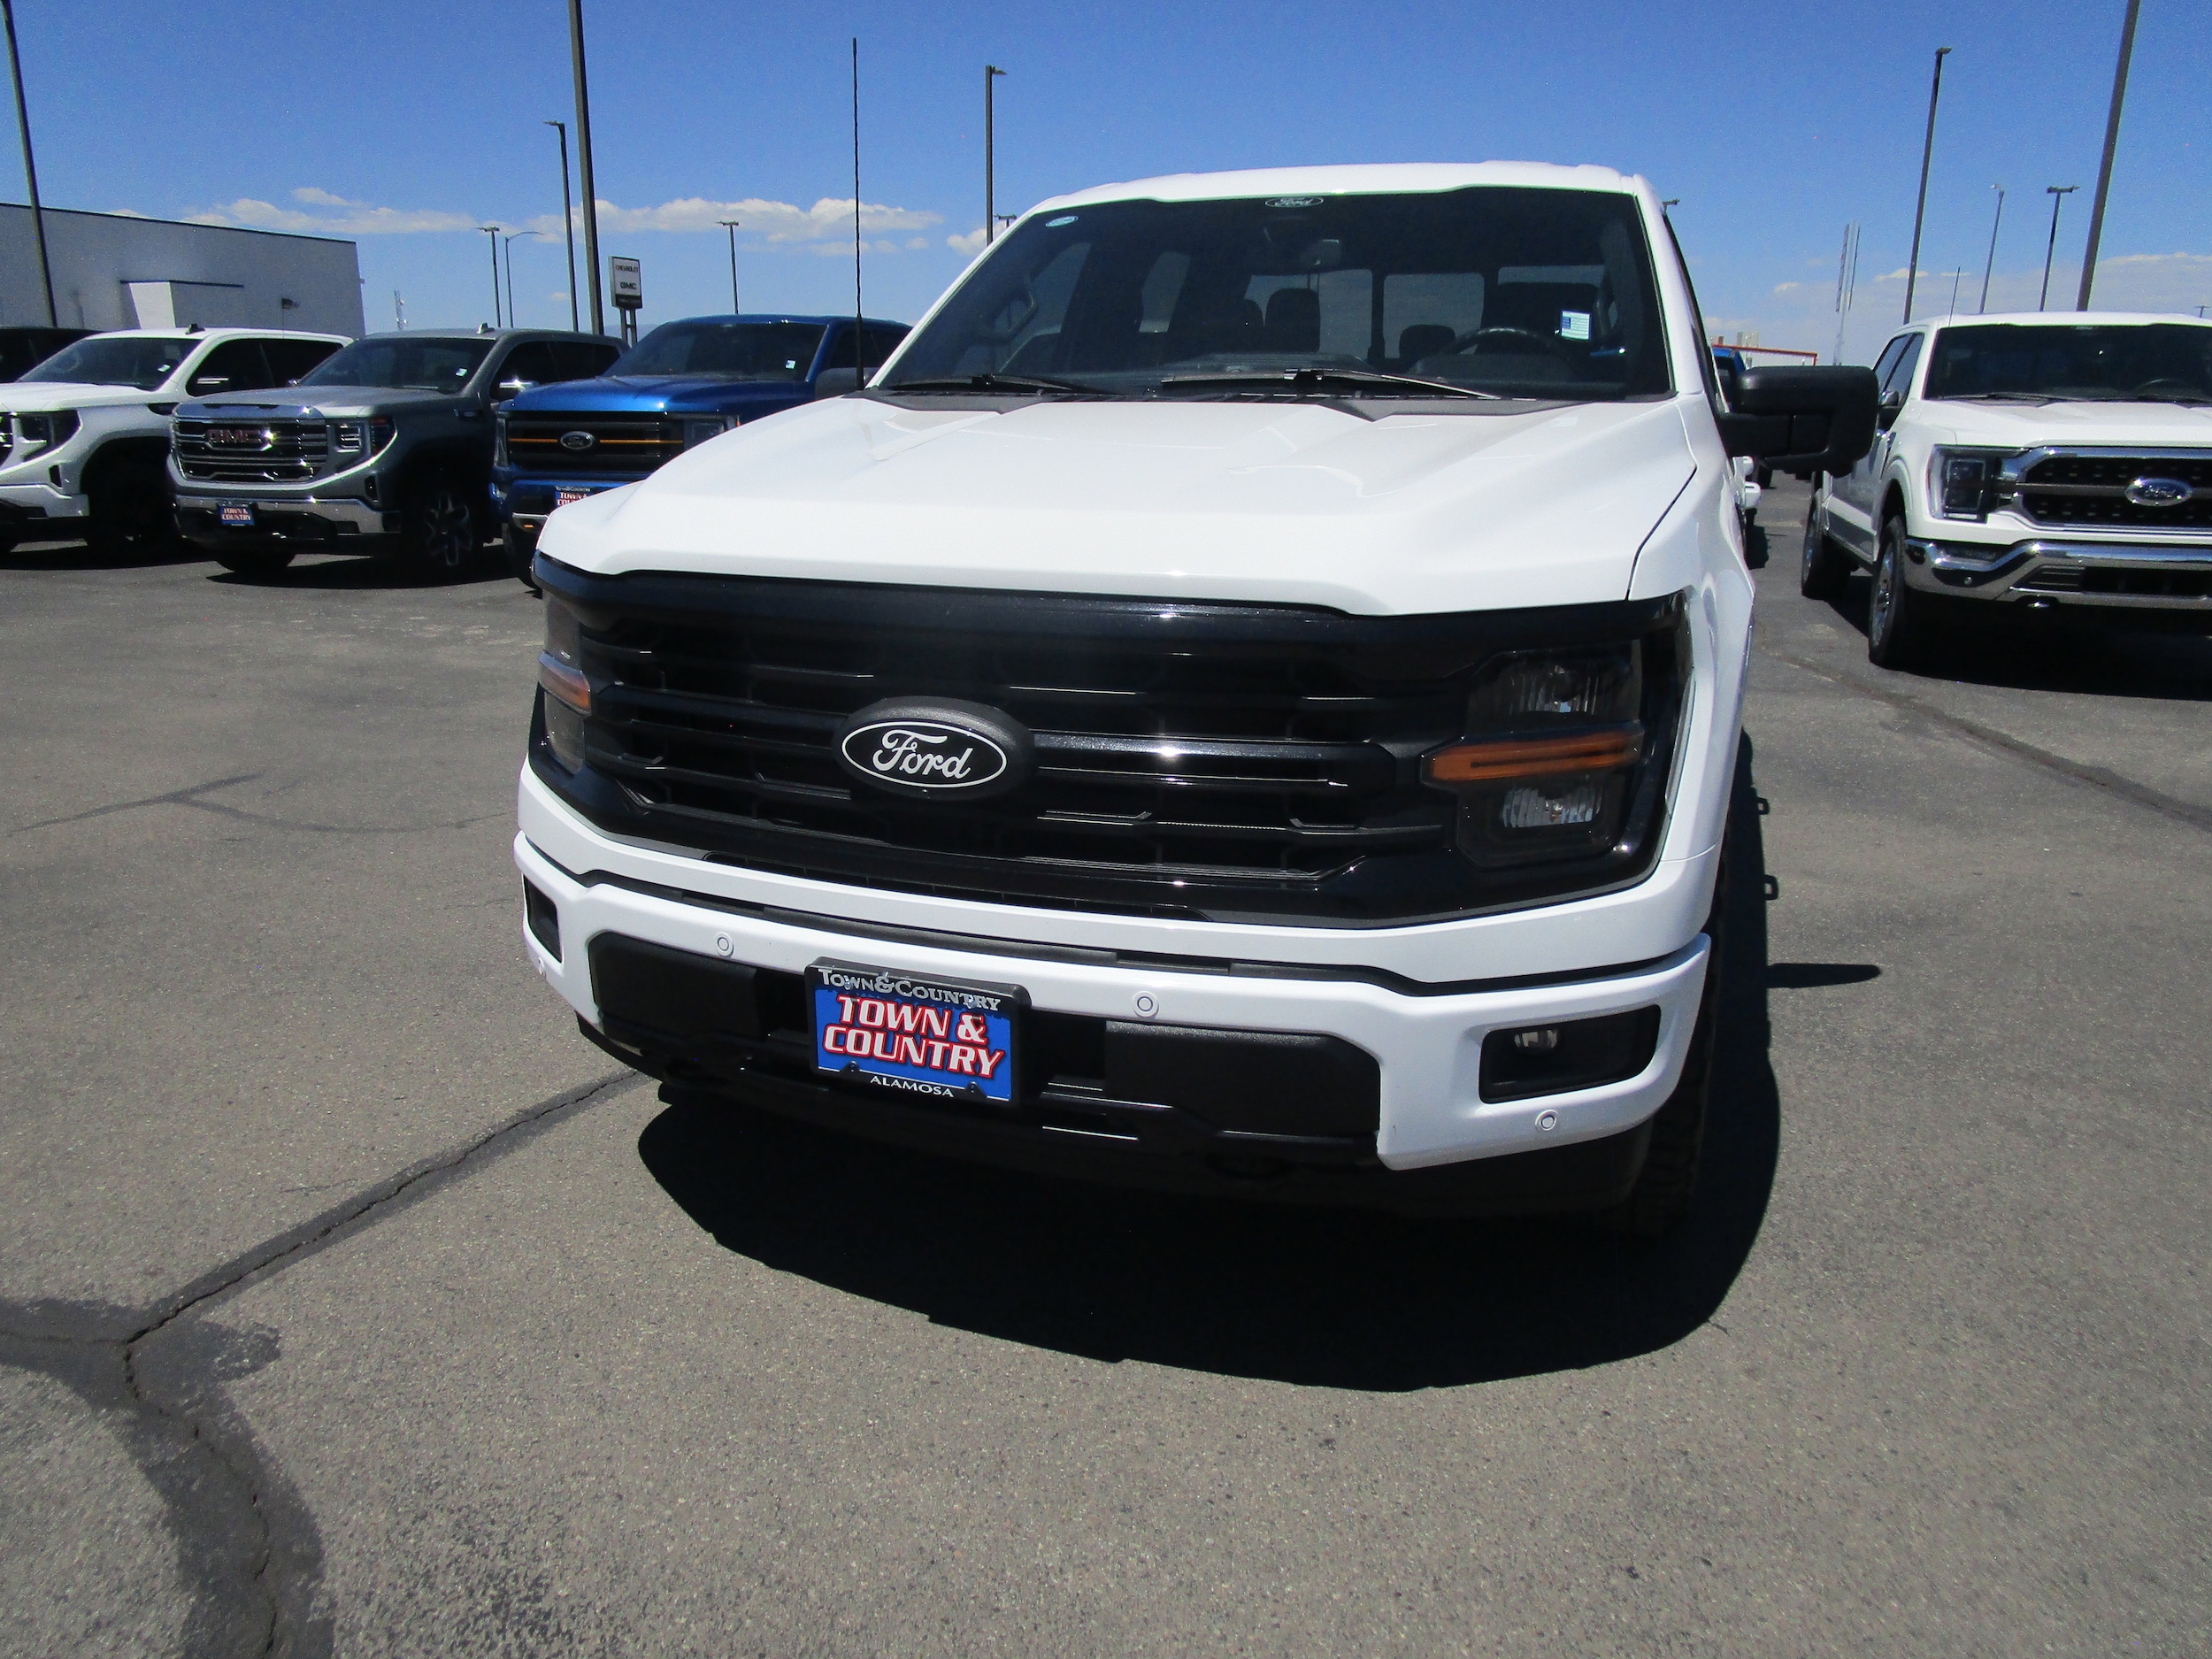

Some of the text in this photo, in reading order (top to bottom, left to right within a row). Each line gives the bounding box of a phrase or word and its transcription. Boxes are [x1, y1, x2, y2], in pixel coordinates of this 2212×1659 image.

[619, 281, 637, 290] GMC
[206, 429, 262, 443] GMC
[872, 729, 973, 780] Ford
[836, 994, 988, 1046] TOWN &
[823, 1024, 1006, 1079] COUNTRY
[870, 1075, 955, 1098] ALAMOSA
